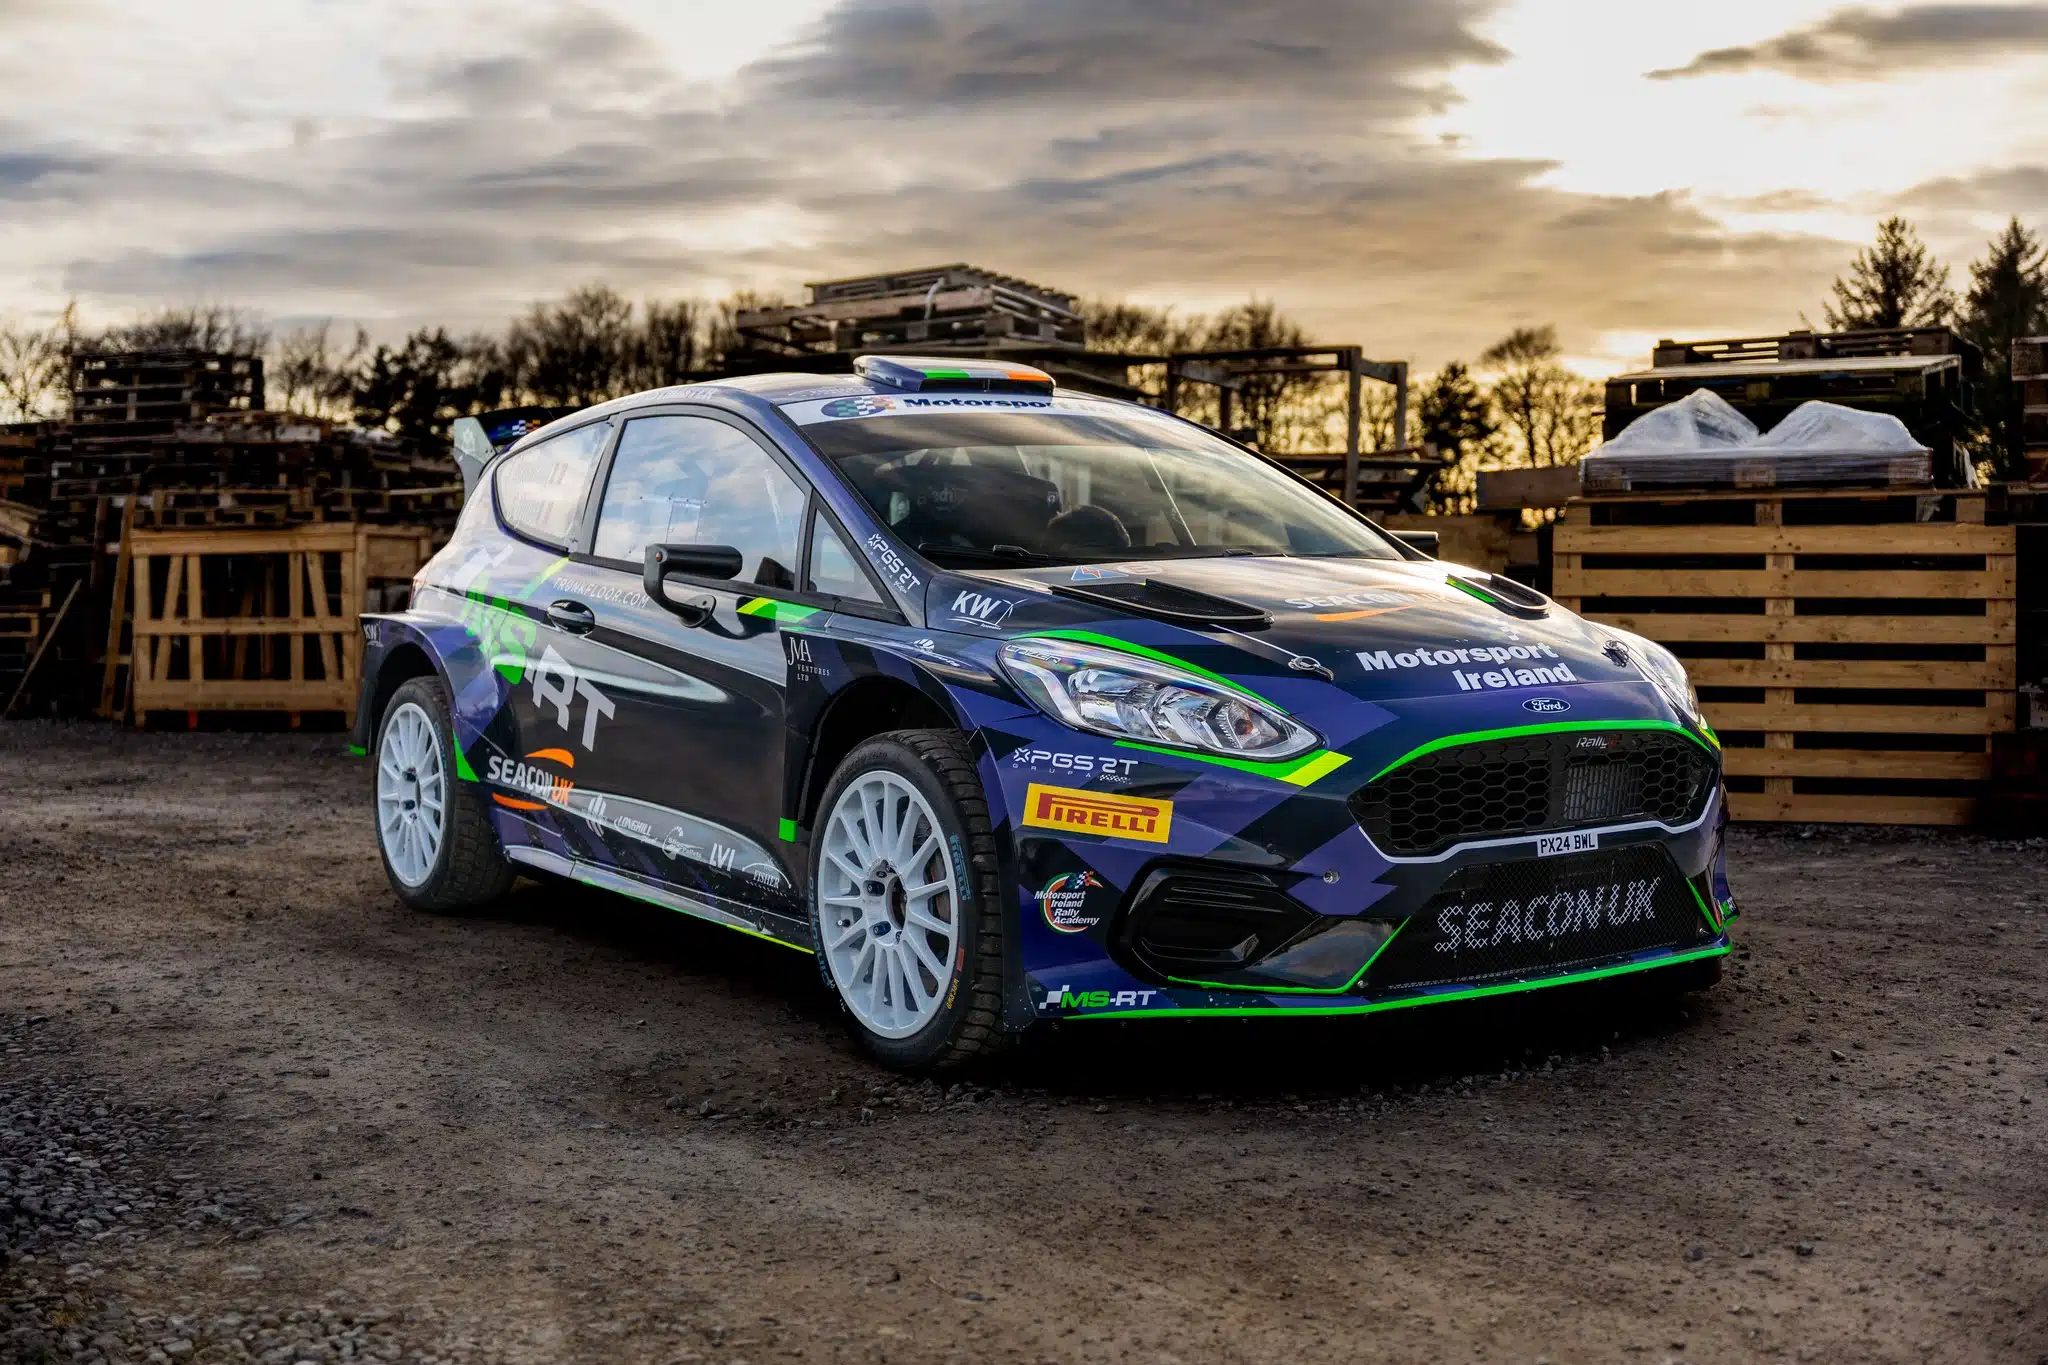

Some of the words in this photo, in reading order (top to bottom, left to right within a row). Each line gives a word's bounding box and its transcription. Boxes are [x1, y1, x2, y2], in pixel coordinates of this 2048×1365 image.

[553, 578, 650, 608] TRUNKFLOOR.COM
[951, 590, 1001, 619] KW
[1355, 642, 1559, 671] Motorsport
[797, 664, 830, 676] VENTURES
[797, 673, 810, 682] LTD
[1452, 662, 1577, 691] Ireland
[1531, 699, 1565, 711] Ford
[1036, 793, 1160, 833] PIRELLI
[618, 816, 653, 837] LONGHILL
[1540, 836, 1571, 854] PX24
[1574, 833, 1596, 850] BWL
[709, 843, 736, 872] LVI
[753, 869, 780, 889] FISHER
[1034, 890, 1086, 901] Motorsport
[1050, 900, 1084, 908] Ireland
[1053, 916, 1100, 926] Academy
[1054, 908, 1080, 918] Rally
[1061, 991, 1157, 1009] MS-RT
